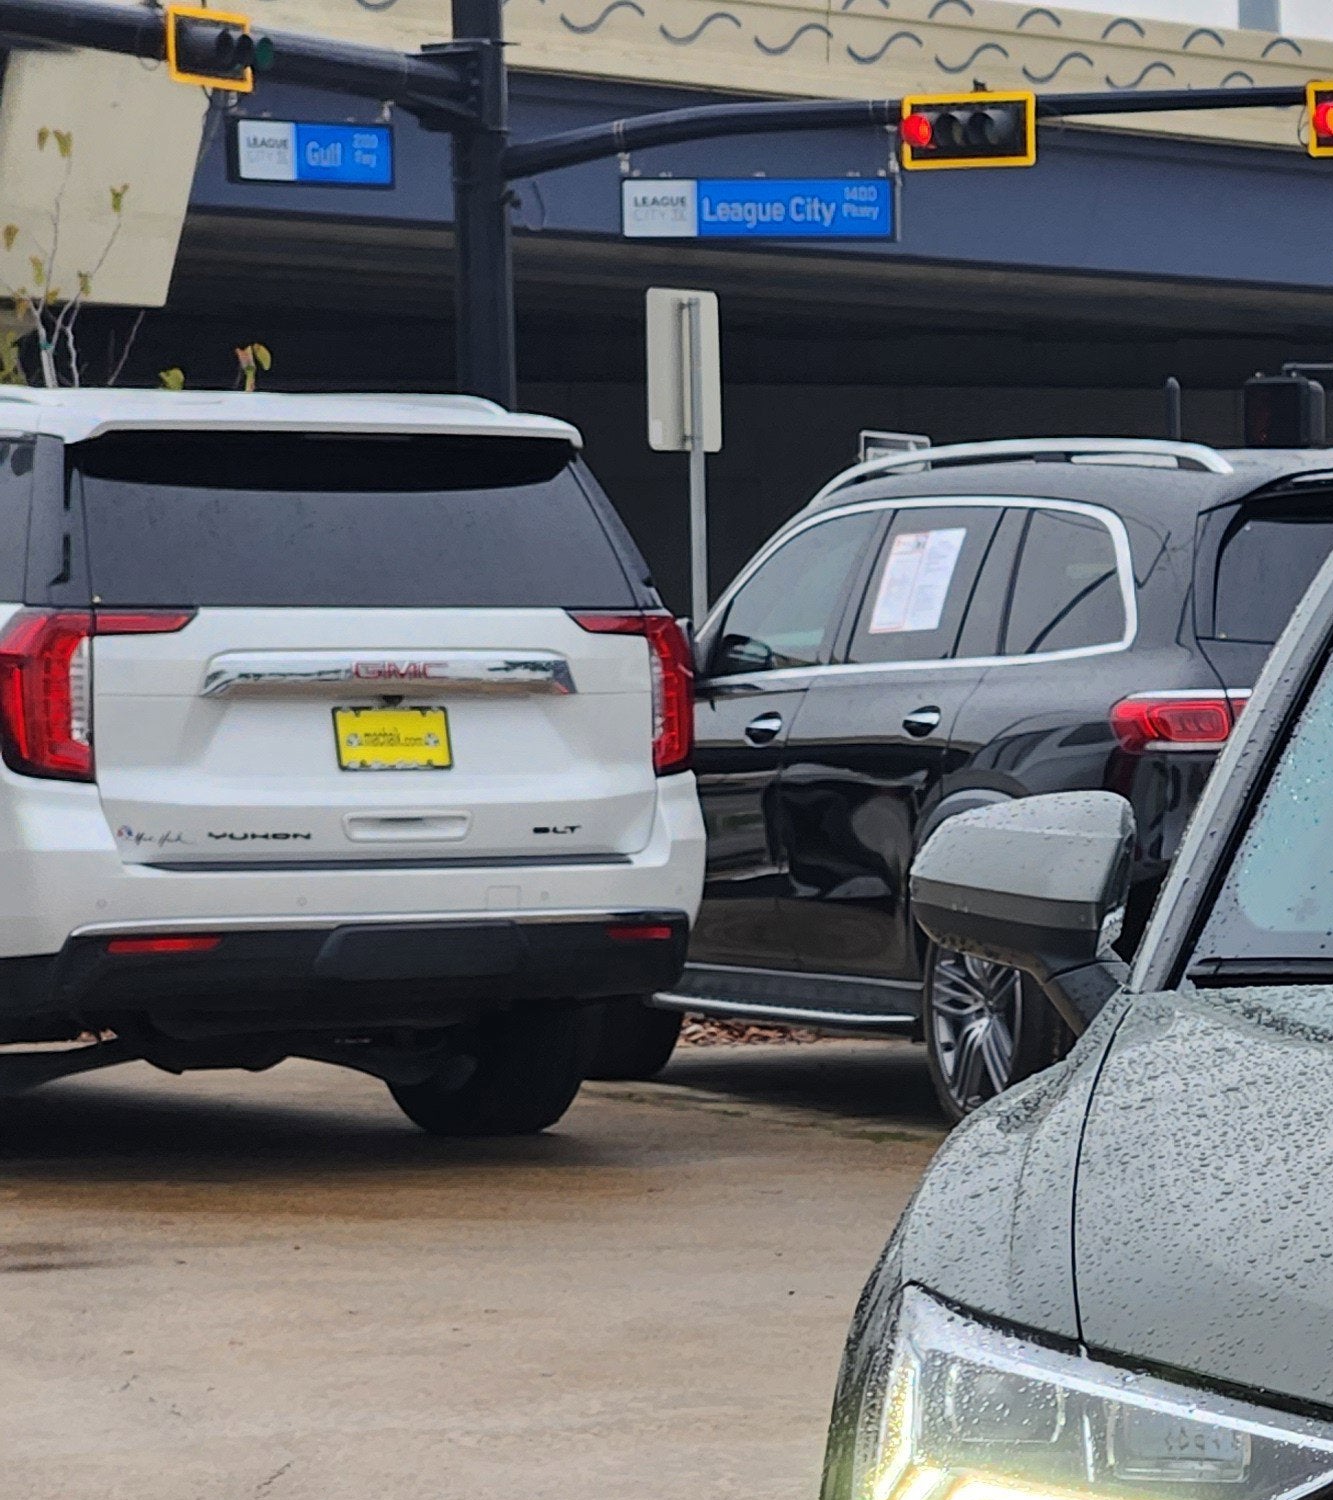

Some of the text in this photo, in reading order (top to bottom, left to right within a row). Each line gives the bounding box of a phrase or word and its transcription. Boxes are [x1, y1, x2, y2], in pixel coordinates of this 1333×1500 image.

[633, 196, 687, 208] LEAGUE
[702, 196, 836, 228] League City
[352, 661, 449, 679] GMC
[207, 832, 311, 841] YUKON
